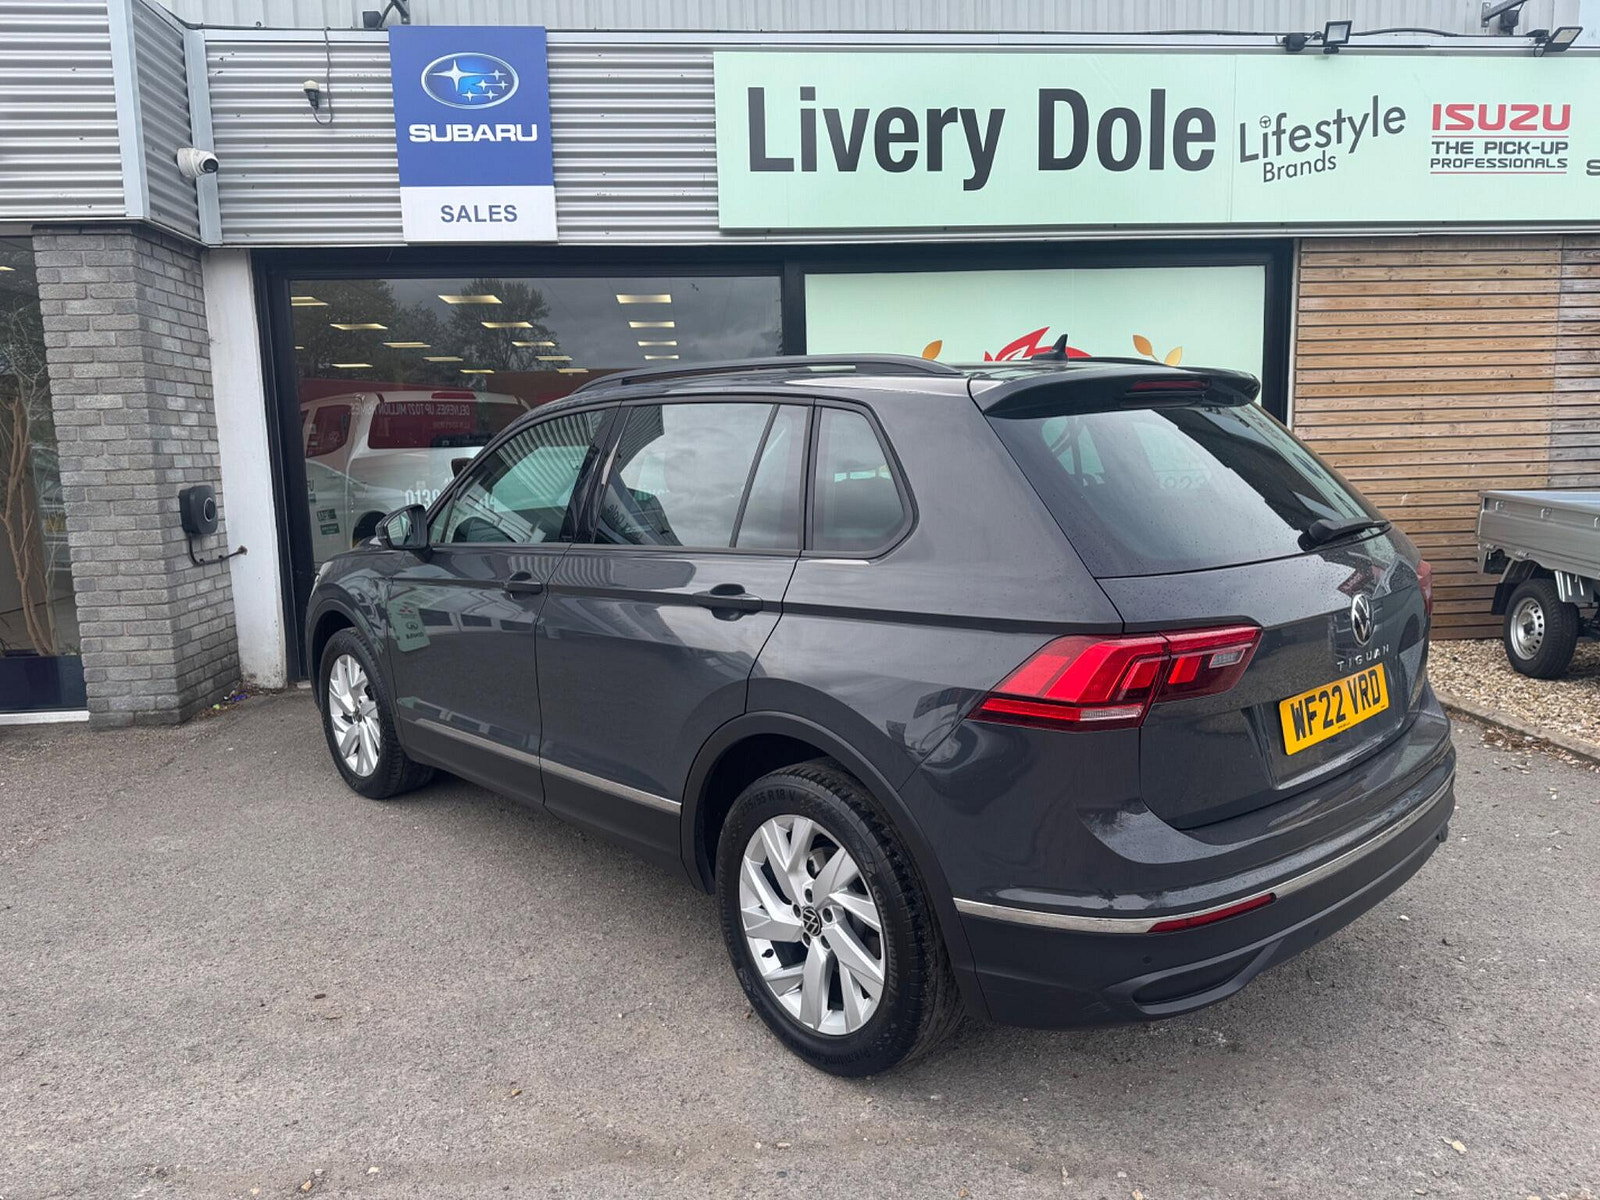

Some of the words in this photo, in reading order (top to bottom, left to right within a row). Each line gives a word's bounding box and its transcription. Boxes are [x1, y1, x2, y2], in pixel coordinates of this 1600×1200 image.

[1239, 95, 1406, 163] Lifestyle
[1431, 103, 1571, 131] ISUZU
[408, 123, 538, 143] SUBARU
[747, 86, 1006, 191] Livery
[1038, 88, 1217, 172] Dole
[1431, 141, 1474, 155] THE
[1484, 141, 1568, 155] PICK-UP
[1263, 150, 1337, 183] Brands
[1429, 158, 1568, 168] PROFESSIONALS
[440, 204, 518, 223] SALES
[1336, 644, 1390, 671] TIGUAN
[1290, 684, 1346, 741] WF22
[1347, 669, 1381, 715] VRD
